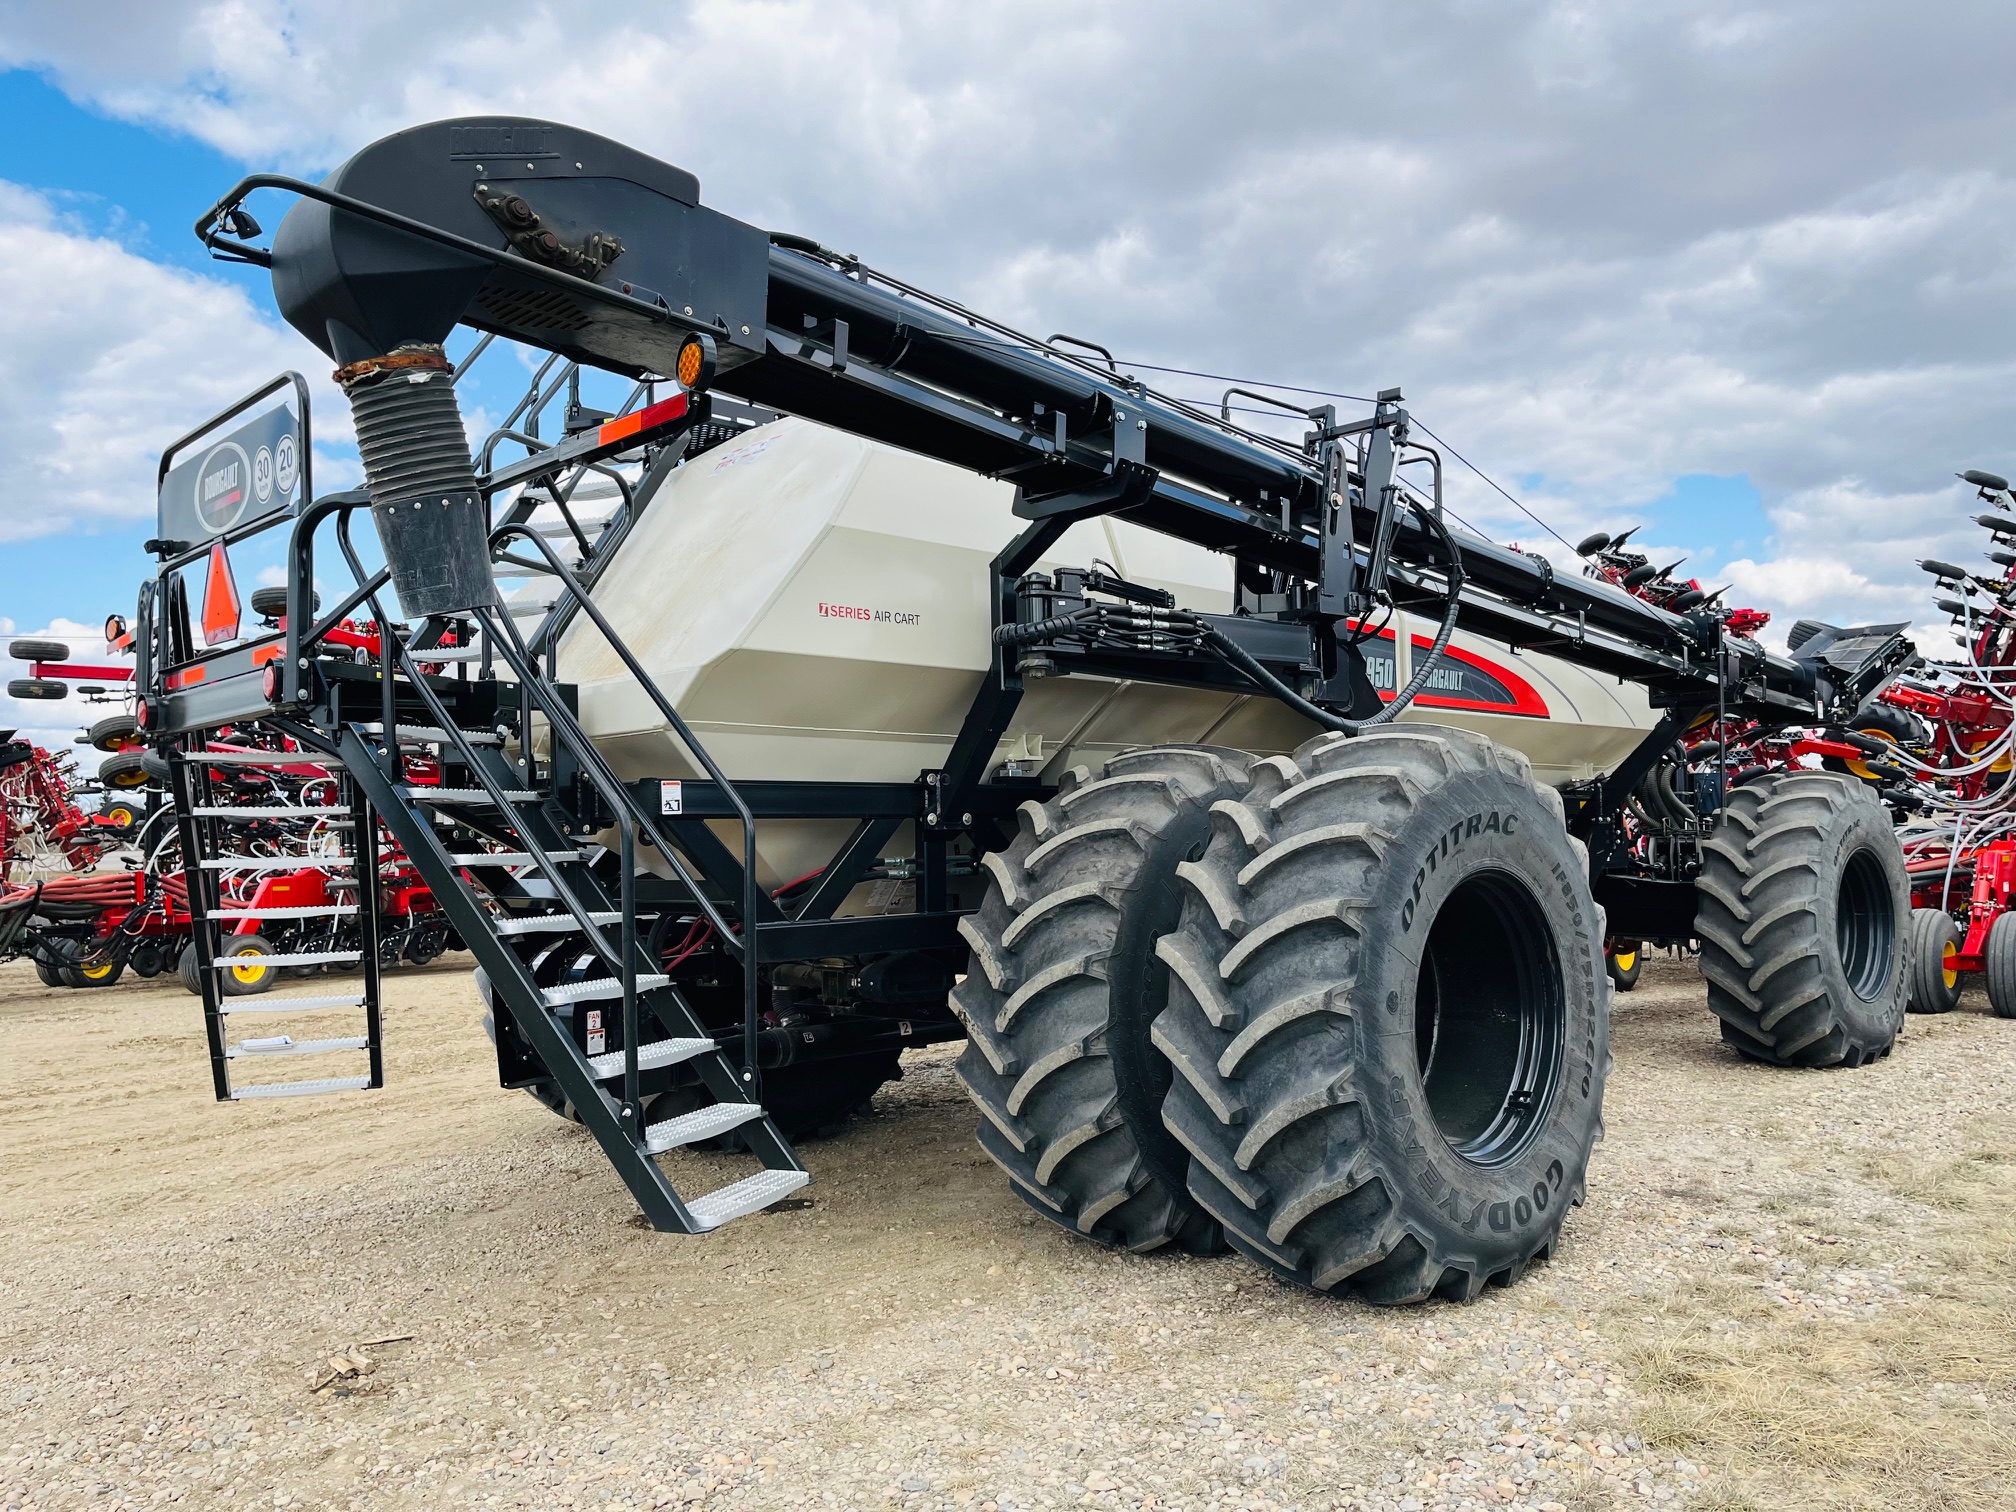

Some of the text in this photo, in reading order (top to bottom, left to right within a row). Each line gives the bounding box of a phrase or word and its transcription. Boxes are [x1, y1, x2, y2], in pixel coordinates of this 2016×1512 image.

[450, 126, 553, 155] BOURGAULT
[257, 456, 269, 482] 30
[280, 446, 293, 472] 20
[204, 462, 238, 501] BOURGAULT
[831, 605, 870, 620] SERIES
[873, 610, 892, 623] AIR
[894, 612, 921, 626] CART
[1363, 656, 1393, 689] 950
[1415, 667, 1463, 690] URGAULT
[1402, 811, 1519, 934] OPTITRAC
[592, 1020, 597, 1028] 2
[902, 1022, 910, 1034] 2
[1388, 1075, 1564, 1233] GOODYEAR
